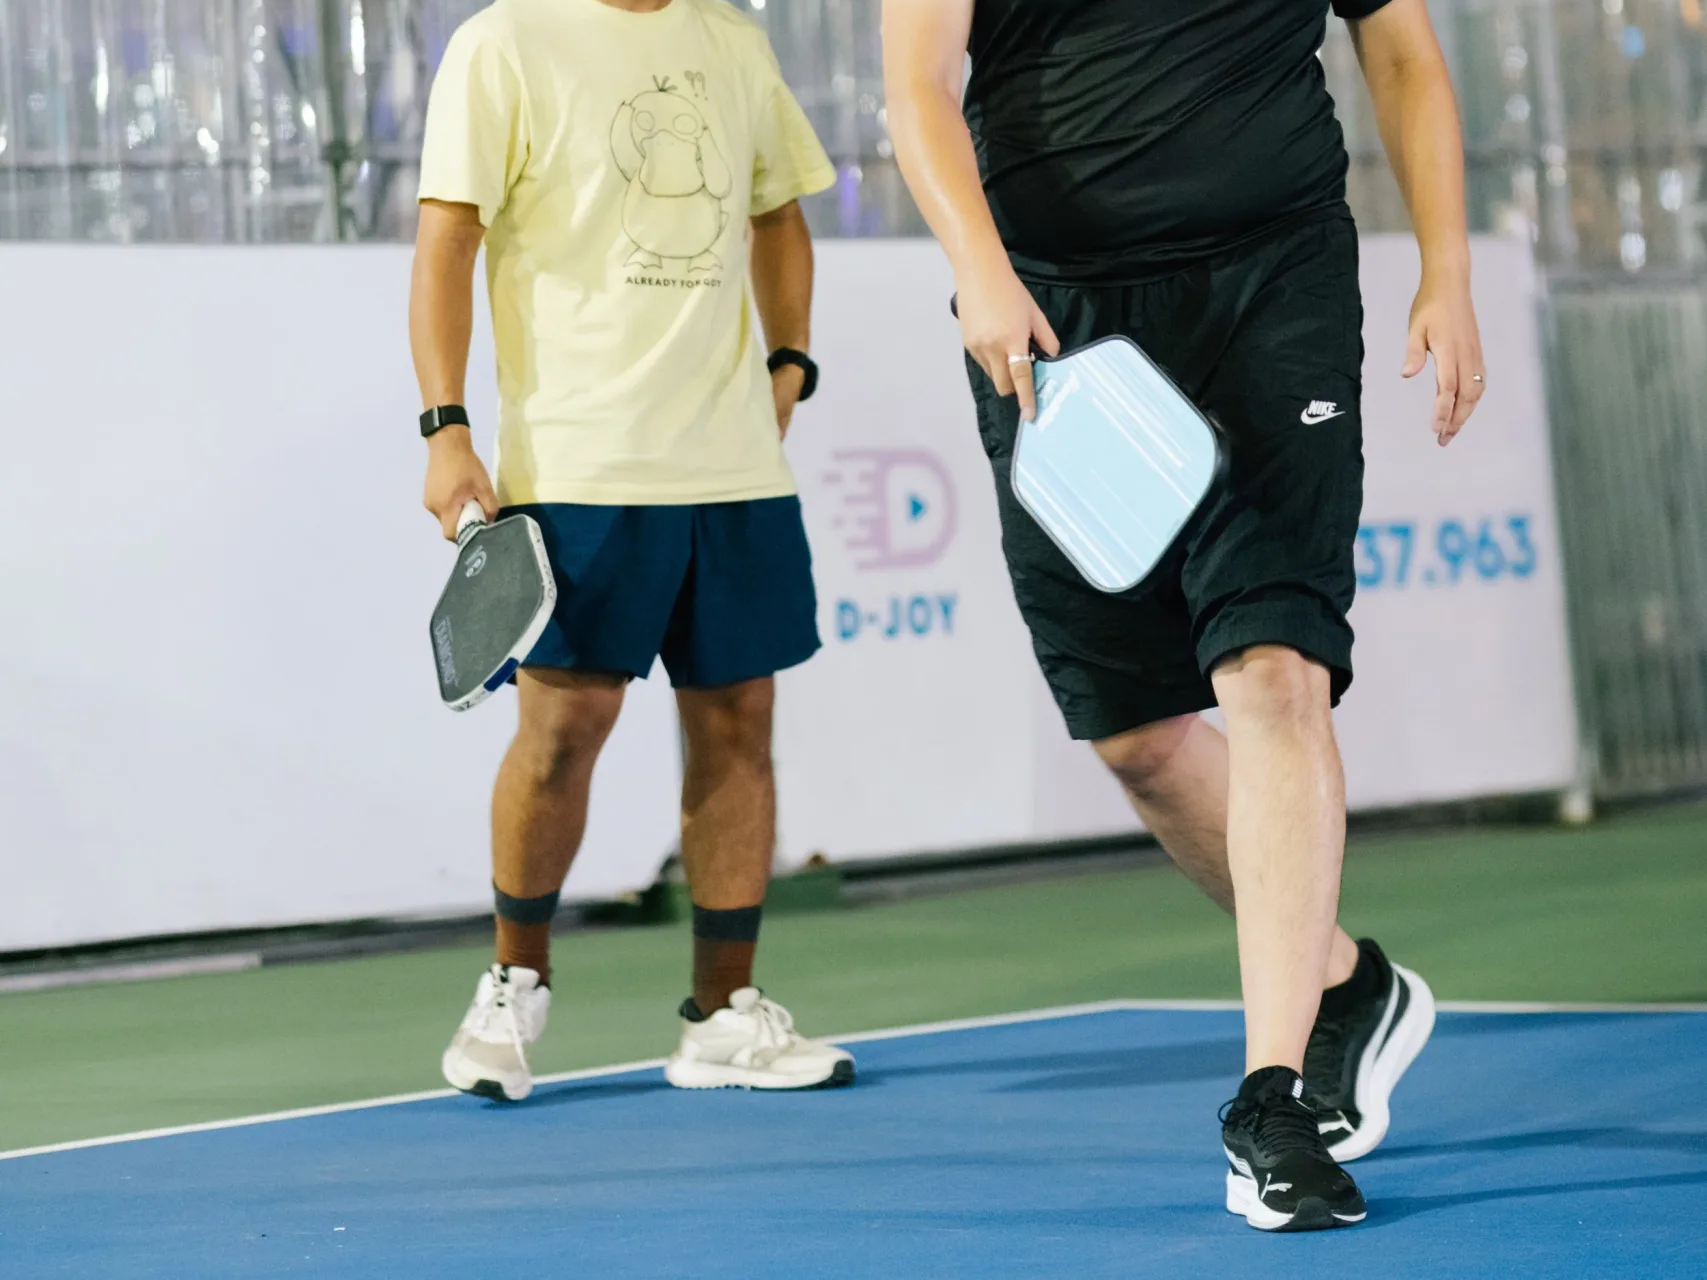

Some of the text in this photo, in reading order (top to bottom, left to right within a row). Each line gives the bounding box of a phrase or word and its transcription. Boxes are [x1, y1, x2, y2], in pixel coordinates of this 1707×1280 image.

[625, 276, 677, 287] ALREADY
[1307, 399, 1337, 416] NIKE
[834, 593, 958, 640] D-JOY
